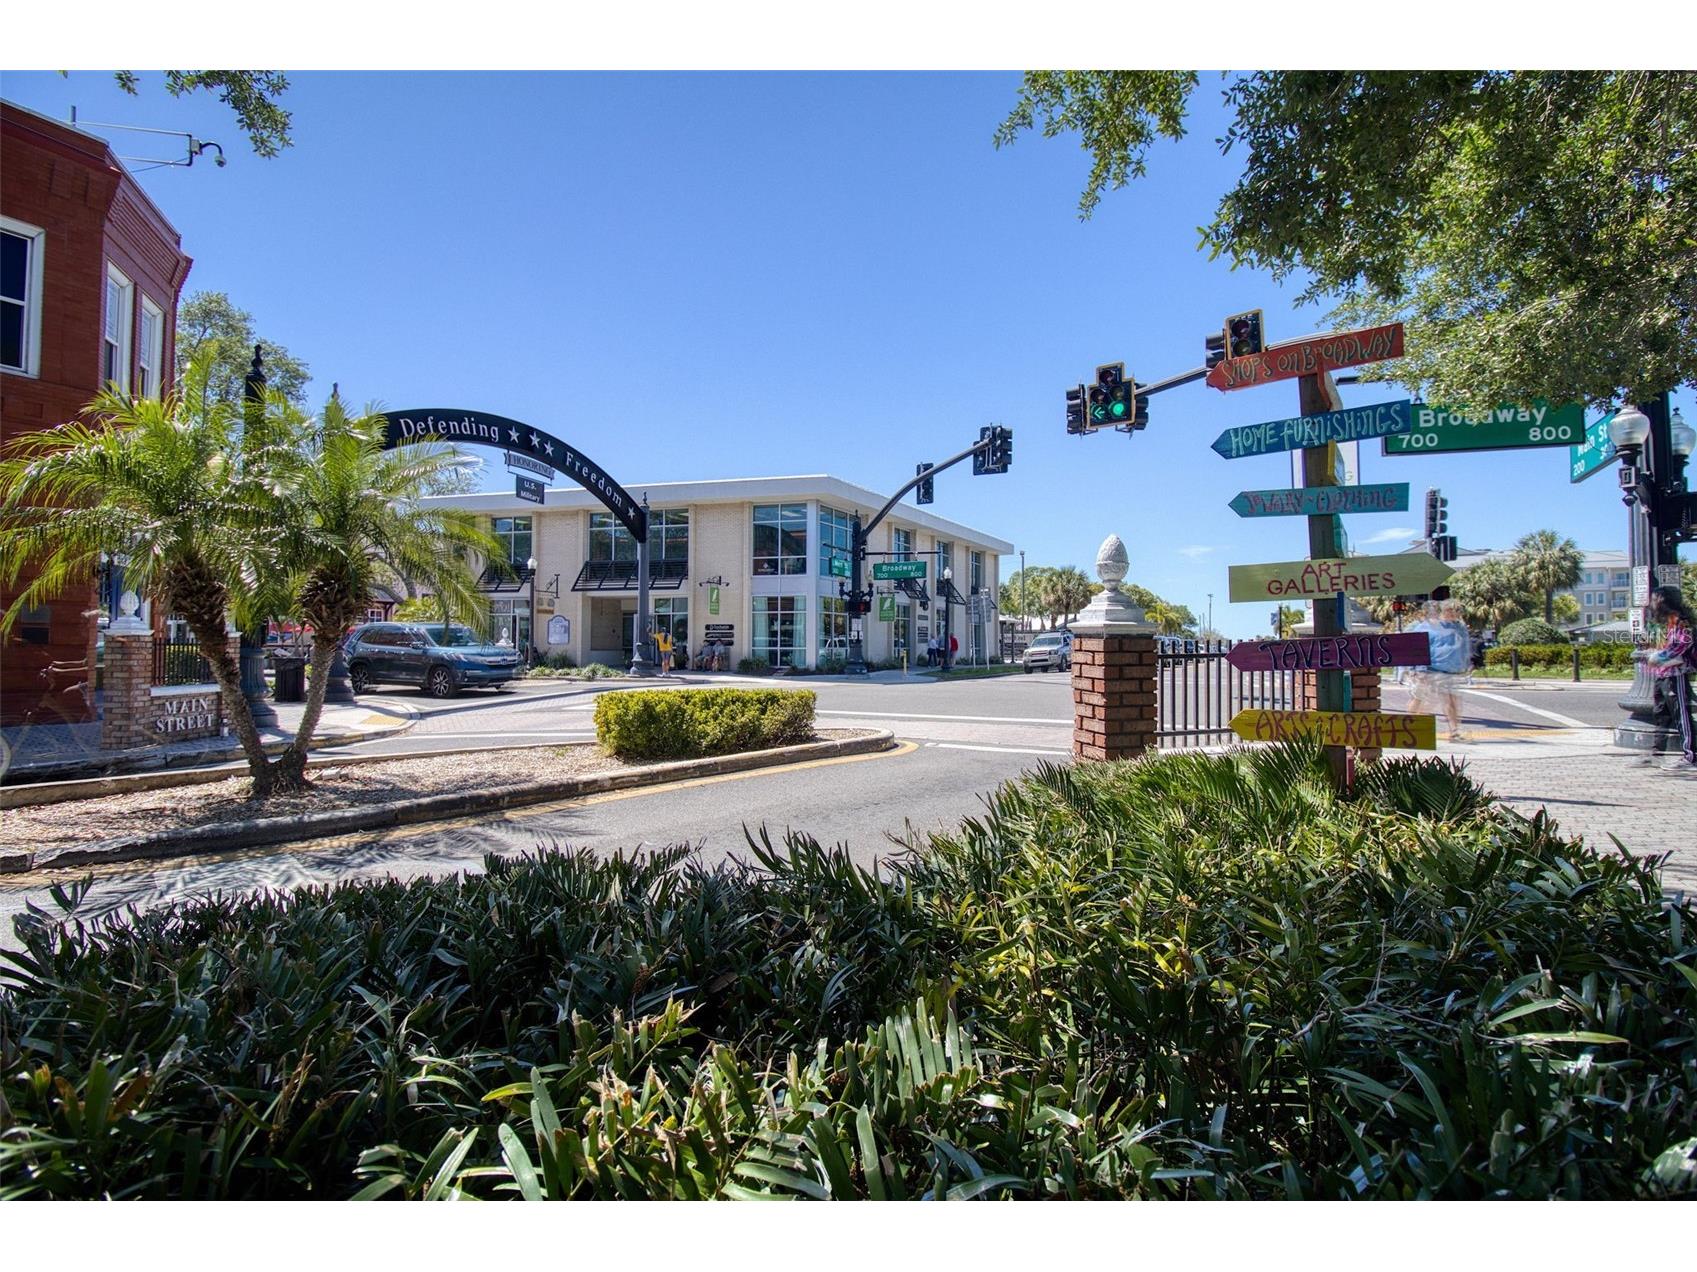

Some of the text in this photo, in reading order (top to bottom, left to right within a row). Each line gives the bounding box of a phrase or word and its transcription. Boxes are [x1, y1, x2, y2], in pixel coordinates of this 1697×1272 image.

[1221, 356, 1273, 387] SHOPS
[399, 415, 499, 443] Defending
[1230, 422, 1279, 457] HOME
[1398, 425, 1572, 449] 700 800
[1573, 459, 1586, 476] 200
[524, 480, 537, 490] U.S.
[566, 450, 623, 508] Freedom
[520, 490, 540, 504] Military
[882, 564, 917, 572] Broadway
[1302, 561, 1347, 580] ART
[1267, 572, 1396, 596] GALLERIES
[1258, 635, 1393, 670] TAVERNS
[164, 697, 209, 715] MAIN
[156, 713, 214, 733] STREET
